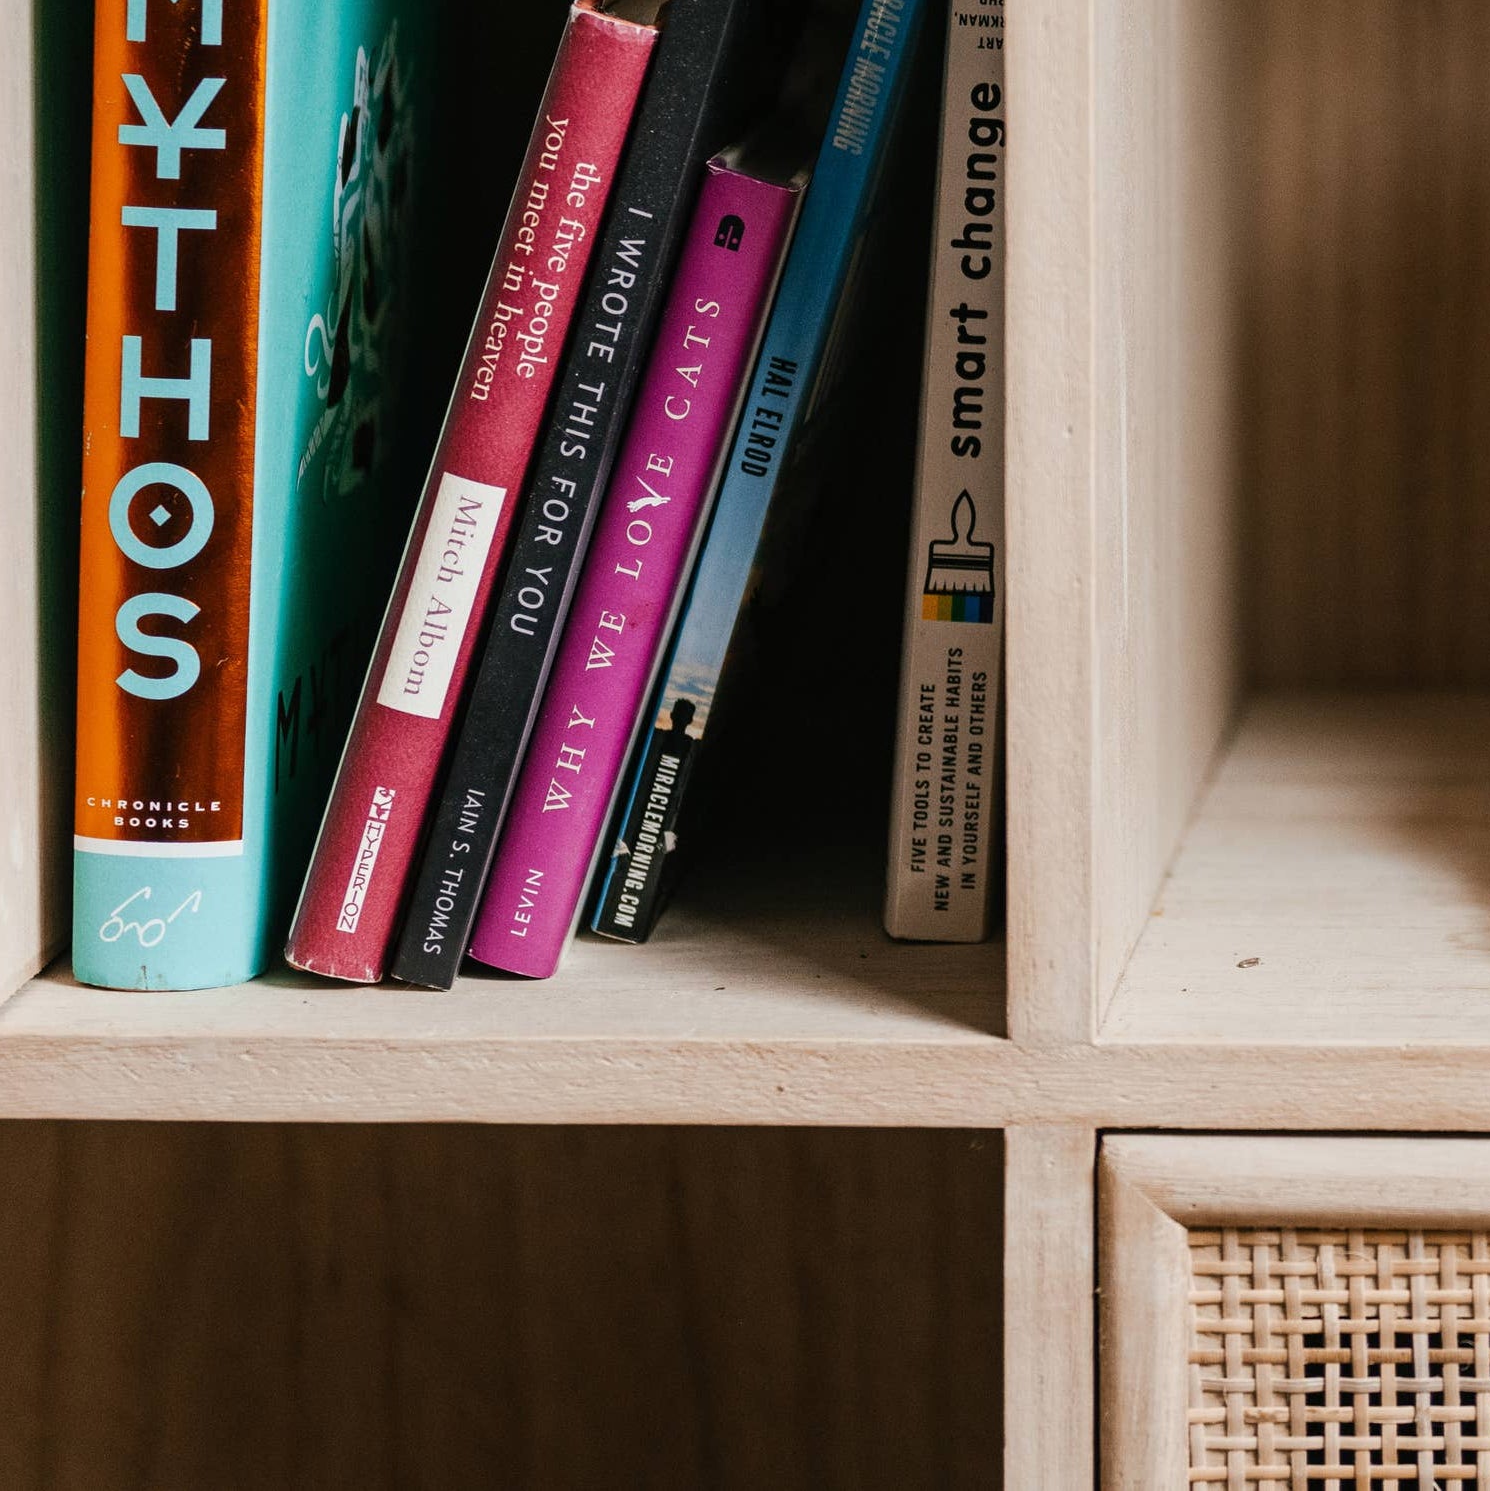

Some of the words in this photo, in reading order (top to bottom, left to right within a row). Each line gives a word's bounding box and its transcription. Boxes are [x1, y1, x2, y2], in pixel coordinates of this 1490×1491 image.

[832, 55, 886, 156] MORNING
[546, 114, 570, 172] you
[566, 161, 602, 208] the
[627, 207, 653, 218] I
[950, 81, 1006, 281] change
[513, 181, 550, 256] meet
[547, 216, 586, 273] five
[503, 263, 534, 292] in
[587, 238, 647, 364] WROTE
[470, 300, 524, 402] heaven
[516, 277, 560, 379] people
[760, 355, 798, 399] HAL
[950, 301, 988, 459] smart
[560, 381, 606, 461] THIS
[740, 408, 783, 479] ELROD
[434, 493, 484, 584] Mitch
[534, 475, 577, 547] FOR
[542, 703, 596, 814] WHY
[585, 610, 627, 672] WE
[614, 451, 674, 581] LOVE
[664, 297, 721, 422] CATS
[509, 565, 554, 637] YOU
[403, 595, 453, 697] Albom
[945, 646, 964, 708] HABITS
[917, 682, 936, 746] CREATE
[968, 670, 988, 736] OTHERS
[915, 751, 933, 773] TO
[938, 713, 960, 828] SUSTAINABLE
[966, 741, 984, 776] AND
[86, 796, 223, 812] CHRONICLE
[112, 815, 191, 829] BOOKS
[456, 787, 486, 835] IAIN
[912, 779, 931, 832] TOOLS
[961, 782, 981, 868] YOURSELF
[448, 836, 472, 860] S.
[613, 753, 681, 929] MIRACLEMORNING.COM
[910, 836, 928, 874] FIVE
[936, 832, 953, 867] AND
[338, 821, 384, 932] HYPERION
[509, 867, 545, 938] LEVIN
[933, 873, 952, 912] NEW
[960, 872, 976, 890] IN
[423, 867, 464, 957] THOMAS
